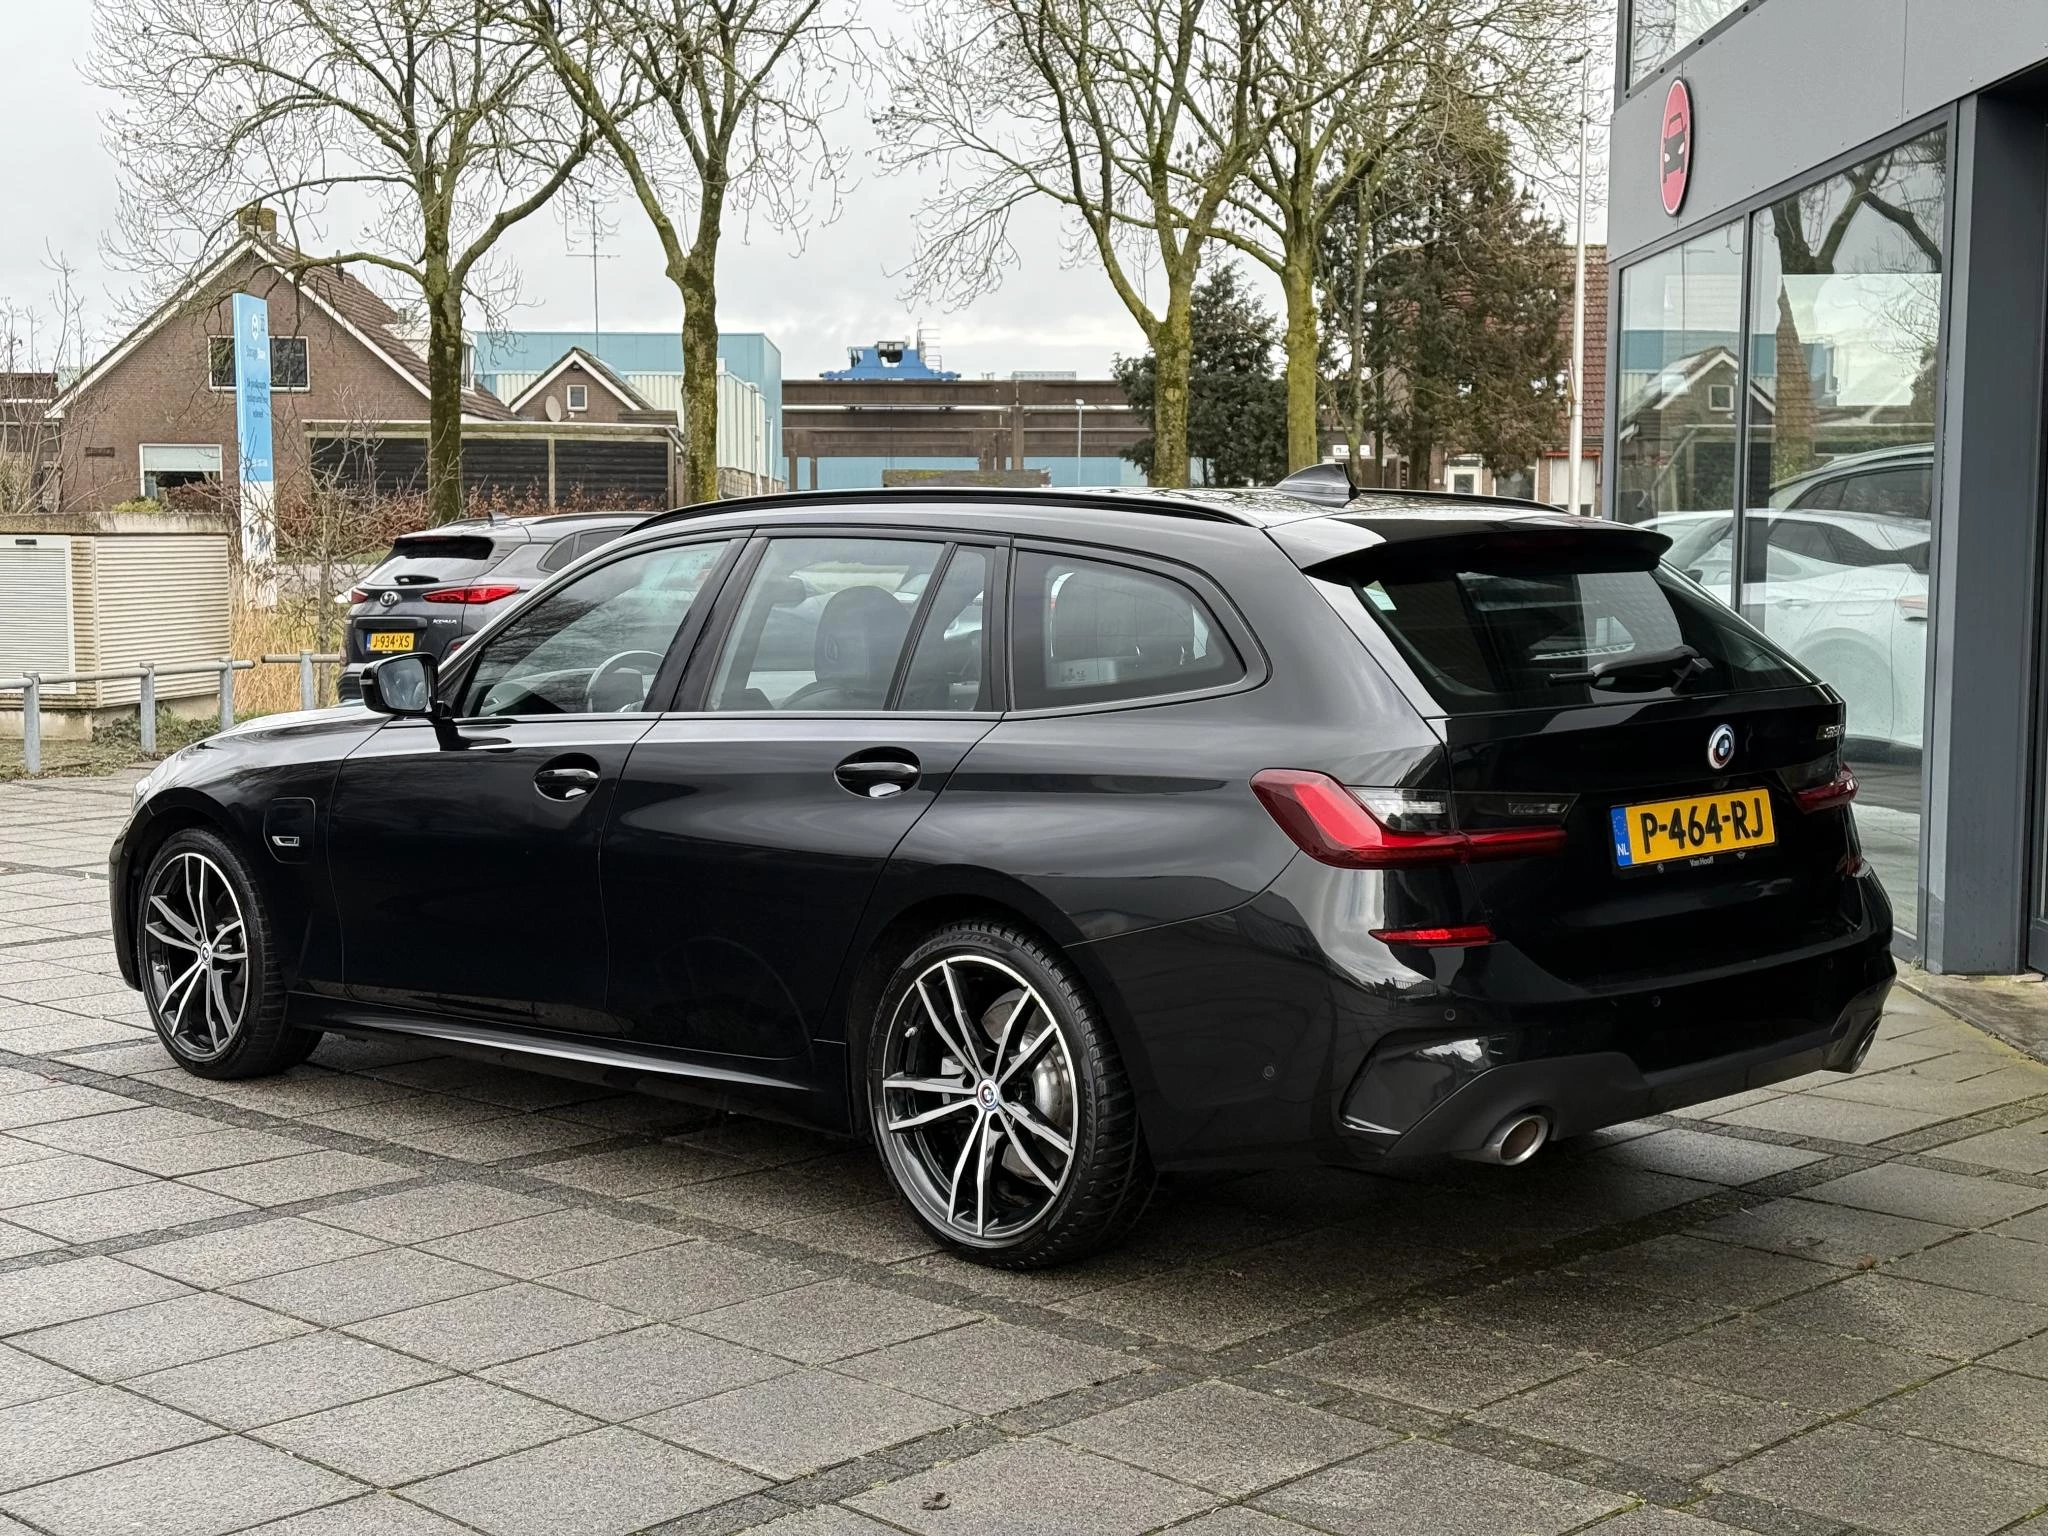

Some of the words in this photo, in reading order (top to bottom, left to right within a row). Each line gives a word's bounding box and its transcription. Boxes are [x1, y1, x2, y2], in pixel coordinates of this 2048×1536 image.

[373, 635, 410, 648] J-934-XS
[1640, 797, 1764, 855] P-464-RJ
[1616, 843, 1630, 857] NL
